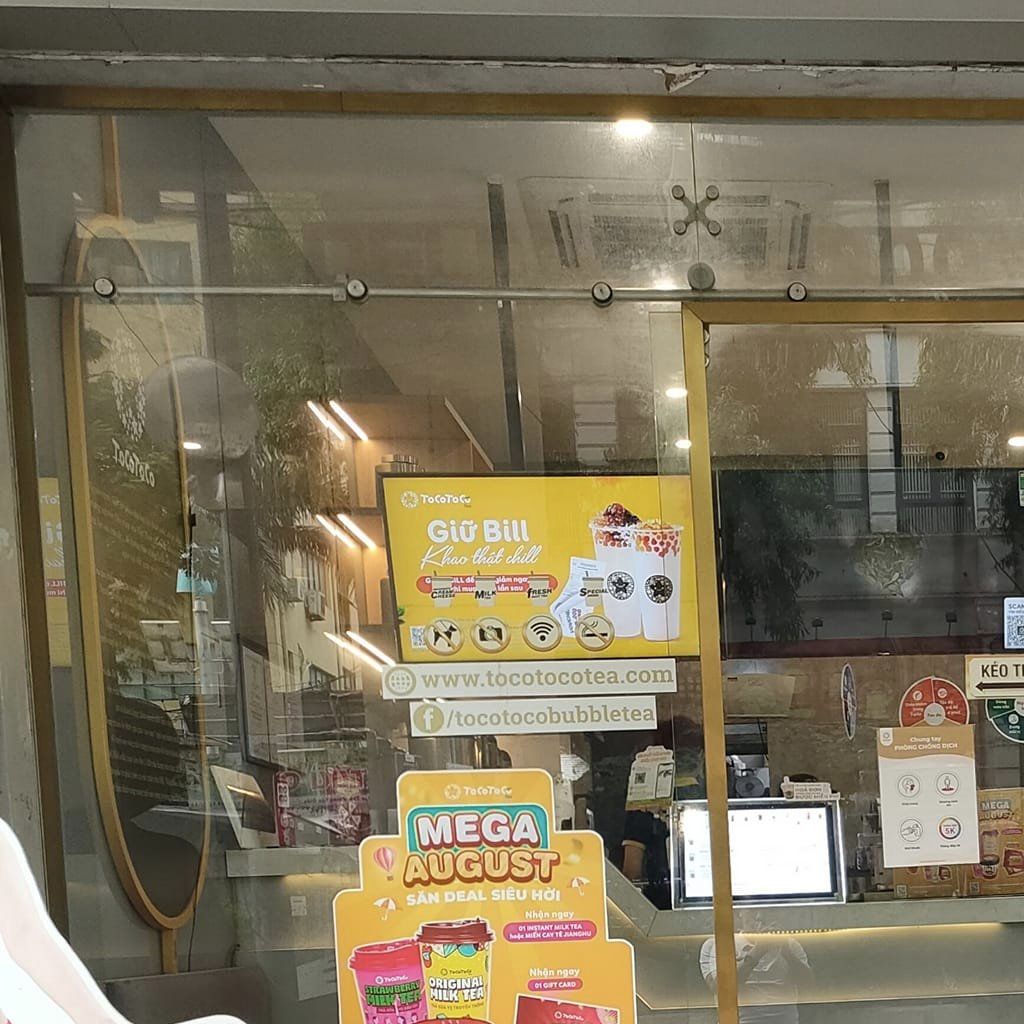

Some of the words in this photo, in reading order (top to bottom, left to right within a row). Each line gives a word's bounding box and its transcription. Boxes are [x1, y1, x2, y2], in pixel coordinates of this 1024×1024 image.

[427, 519, 478, 543] Giữ
[482, 519, 530, 543] Bill
[420, 544, 468, 570] Khao
[506, 544, 543, 564] chill
[421, 667, 675, 689] www.tocotocotea.com
[416, 809, 541, 850] MEGA
[404, 851, 560, 887] AUGUST
[406, 890, 439, 906] SĂN
[444, 889, 487, 904] DEAL
[491, 886, 528, 902] SIÊU
[531, 888, 561, 902] HỜI
[525, 910, 550, 920] Nhận
[551, 910, 574, 920] ngay
[529, 967, 554, 977] Nhận
[556, 967, 580, 976] ngay
[429, 976, 484, 991] ORIGINAL
[430, 989, 459, 1003] MILK
[461, 988, 484, 1002] TEA
